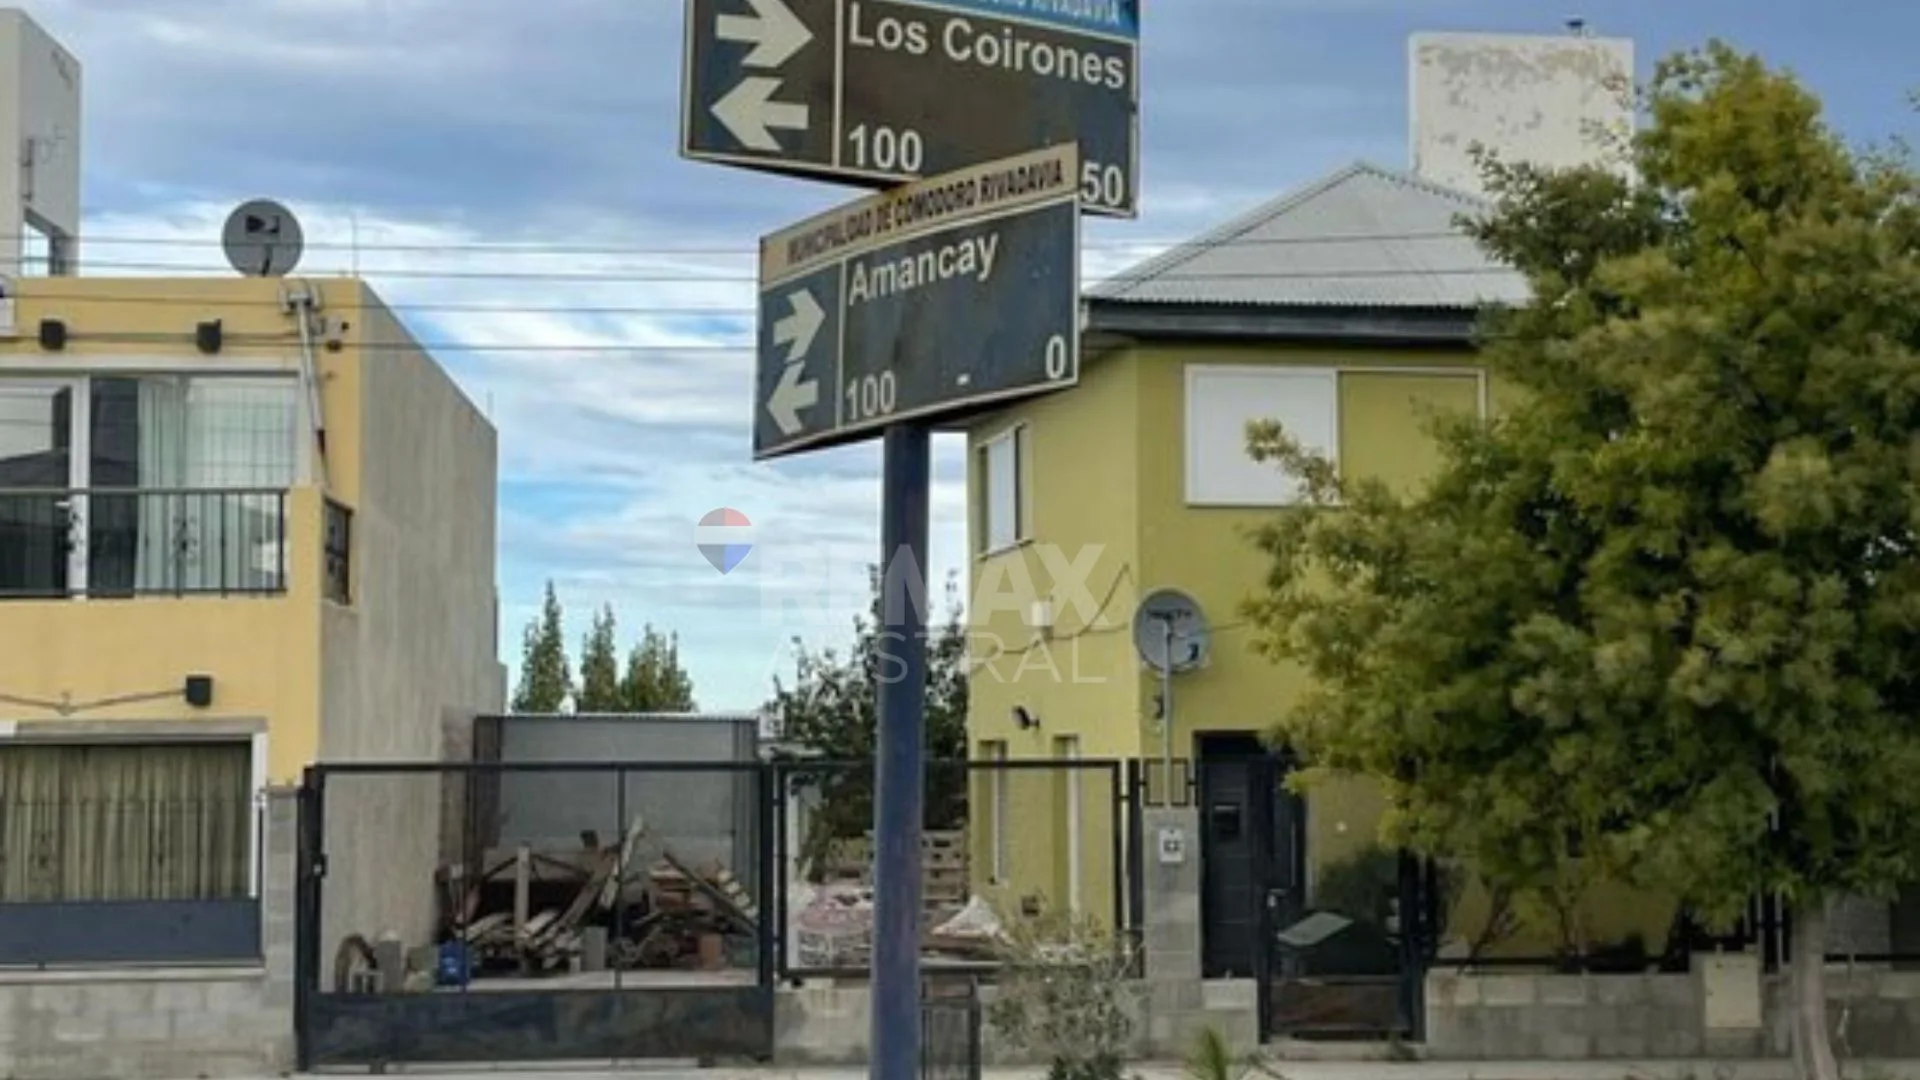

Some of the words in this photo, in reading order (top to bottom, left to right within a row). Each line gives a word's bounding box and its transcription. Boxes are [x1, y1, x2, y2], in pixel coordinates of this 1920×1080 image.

[848, 3, 928, 55] Los
[942, 20, 1125, 89] Coirones
[848, 123, 923, 171] 100
[1080, 162, 1123, 205] 50
[981, 157, 1063, 203] RIVADAVIA
[848, 232, 998, 305] Amancay
[846, 371, 896, 420] 100
[1046, 335, 1066, 380] 0
